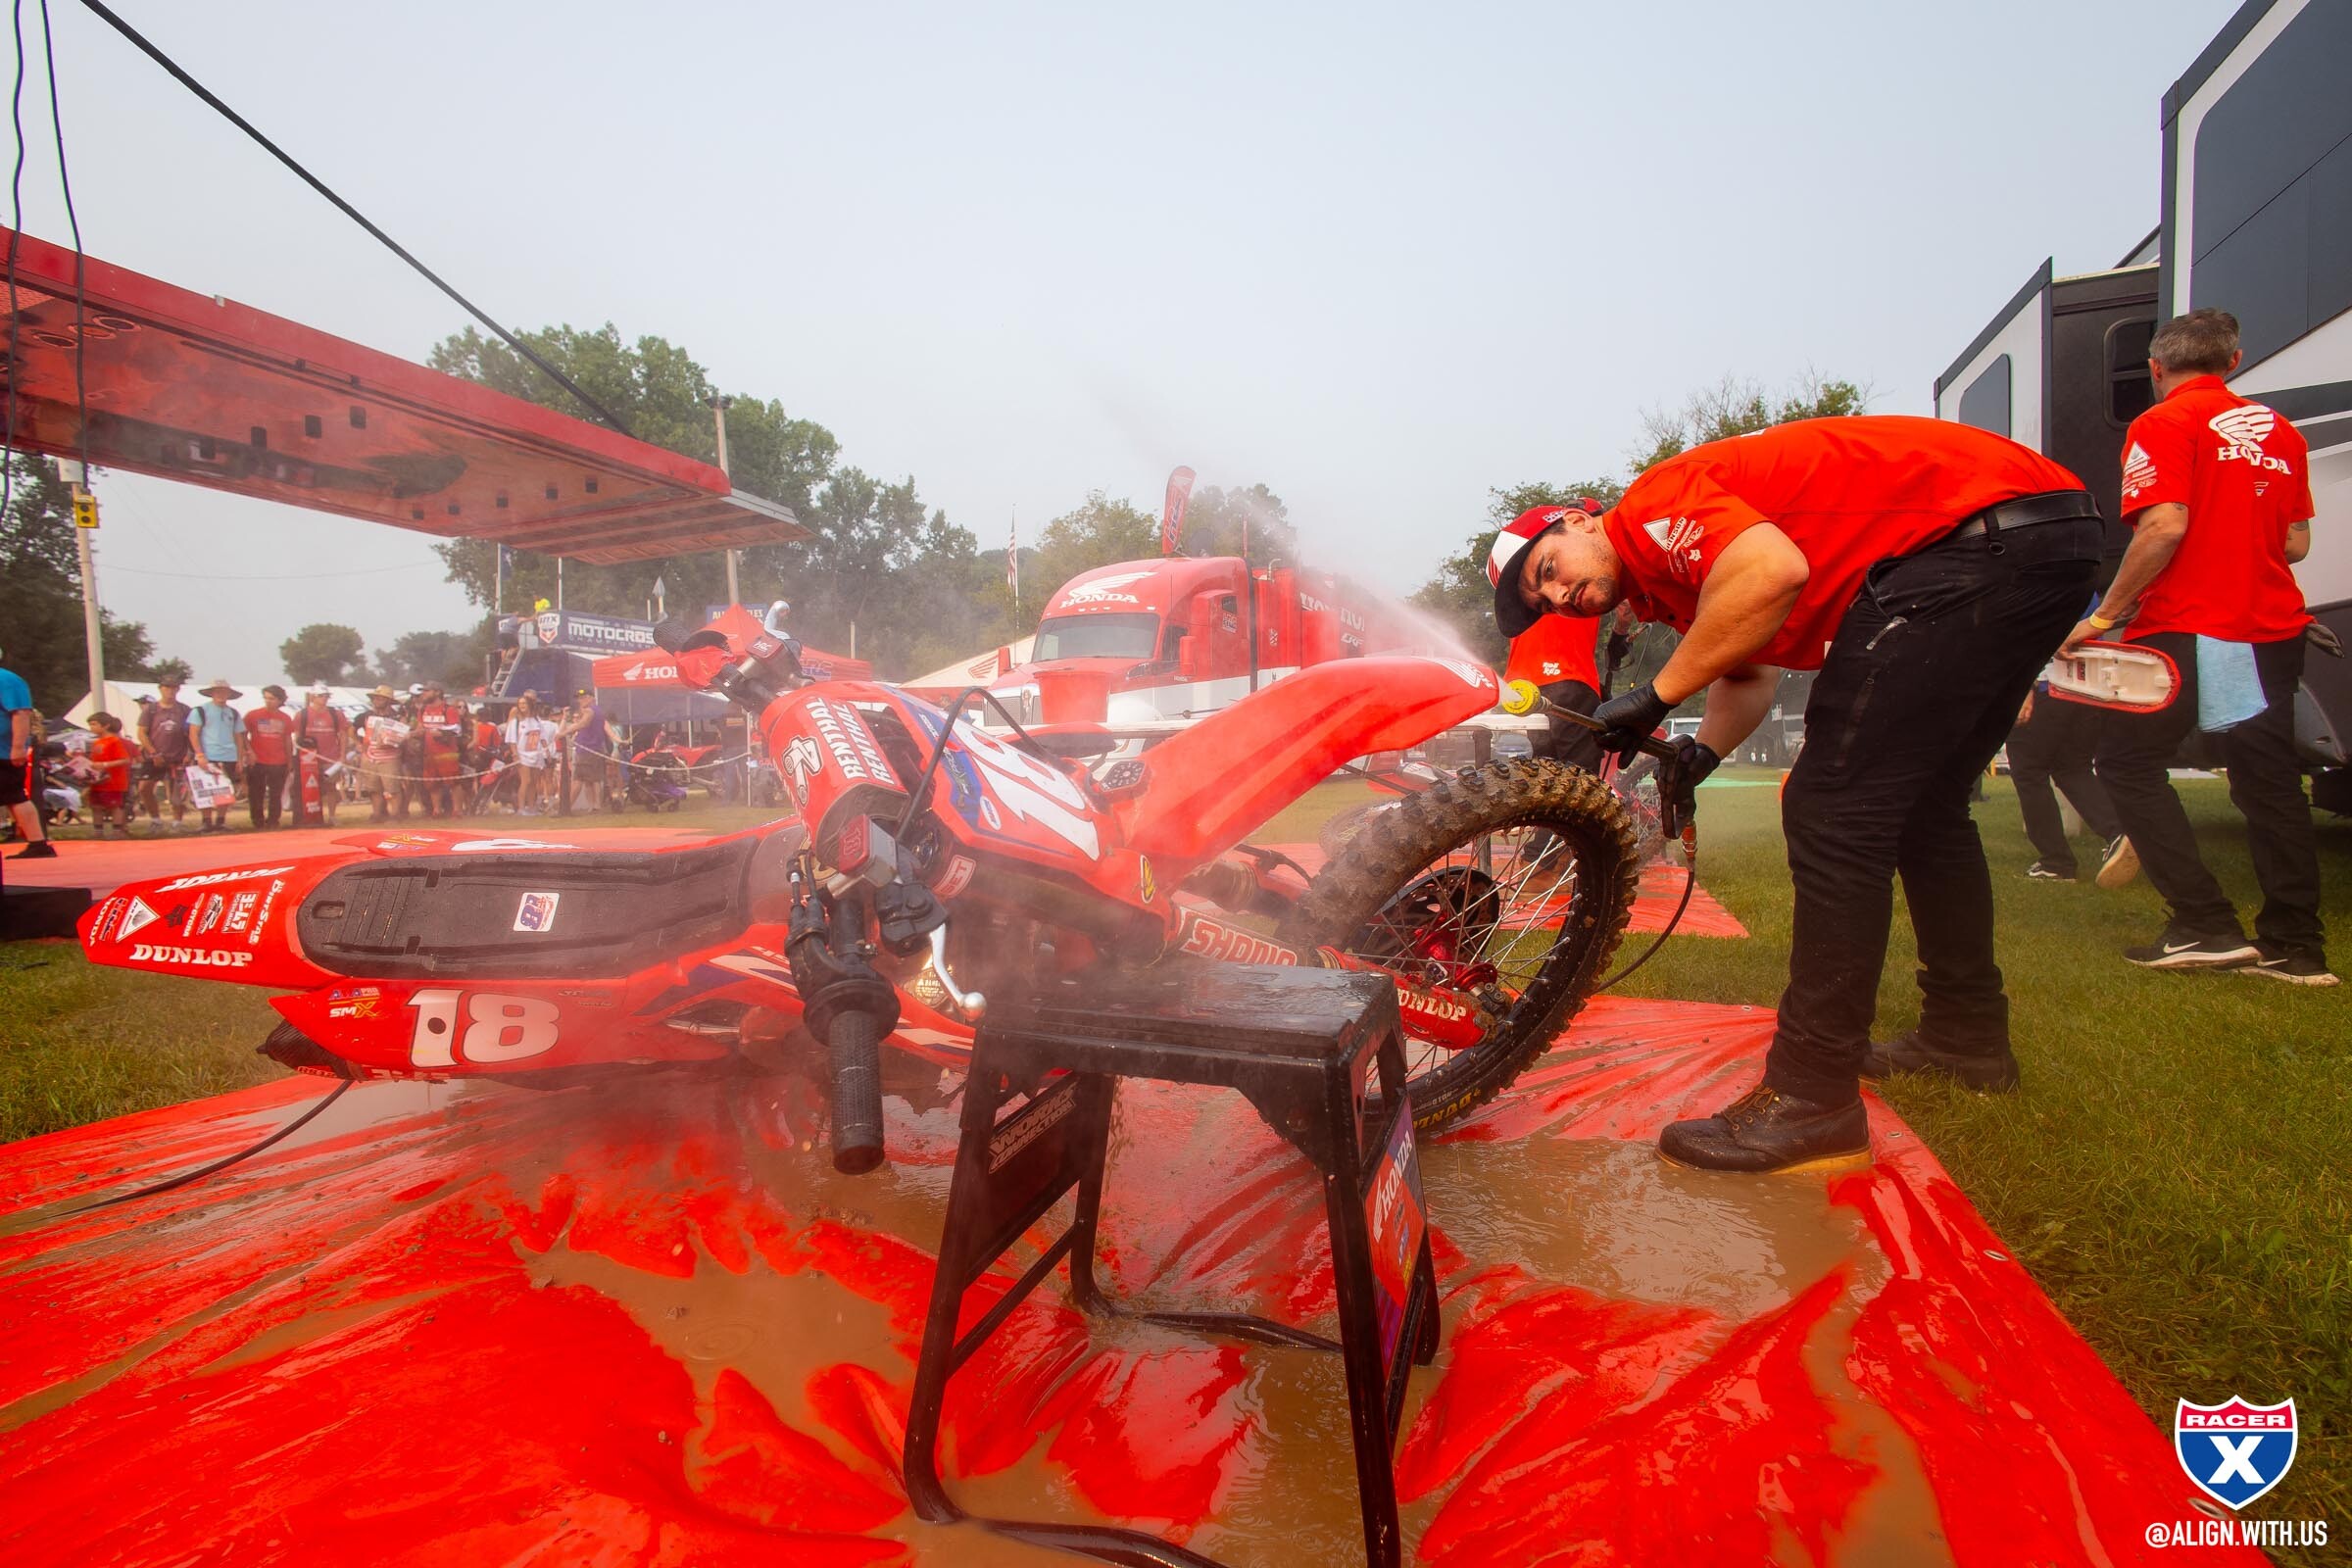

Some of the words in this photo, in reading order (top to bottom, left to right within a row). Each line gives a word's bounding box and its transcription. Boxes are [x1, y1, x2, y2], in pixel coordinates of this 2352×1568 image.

[1058, 593, 1141, 610] HONDA
[567, 622, 656, 645] MOTOCROS
[644, 666, 678, 680] HON
[806, 697, 868, 779] RENTHAL
[831, 704, 895, 785] RENTHAL
[128, 943, 254, 967] DUNLOP
[328, 1001, 378, 1019] SMX
[1397, 987, 1468, 1022] UNLOP
[406, 988, 562, 1069] 18
[1413, 1092, 1473, 1130] DUNL
[1381, 1129, 1413, 1220] HONDA
